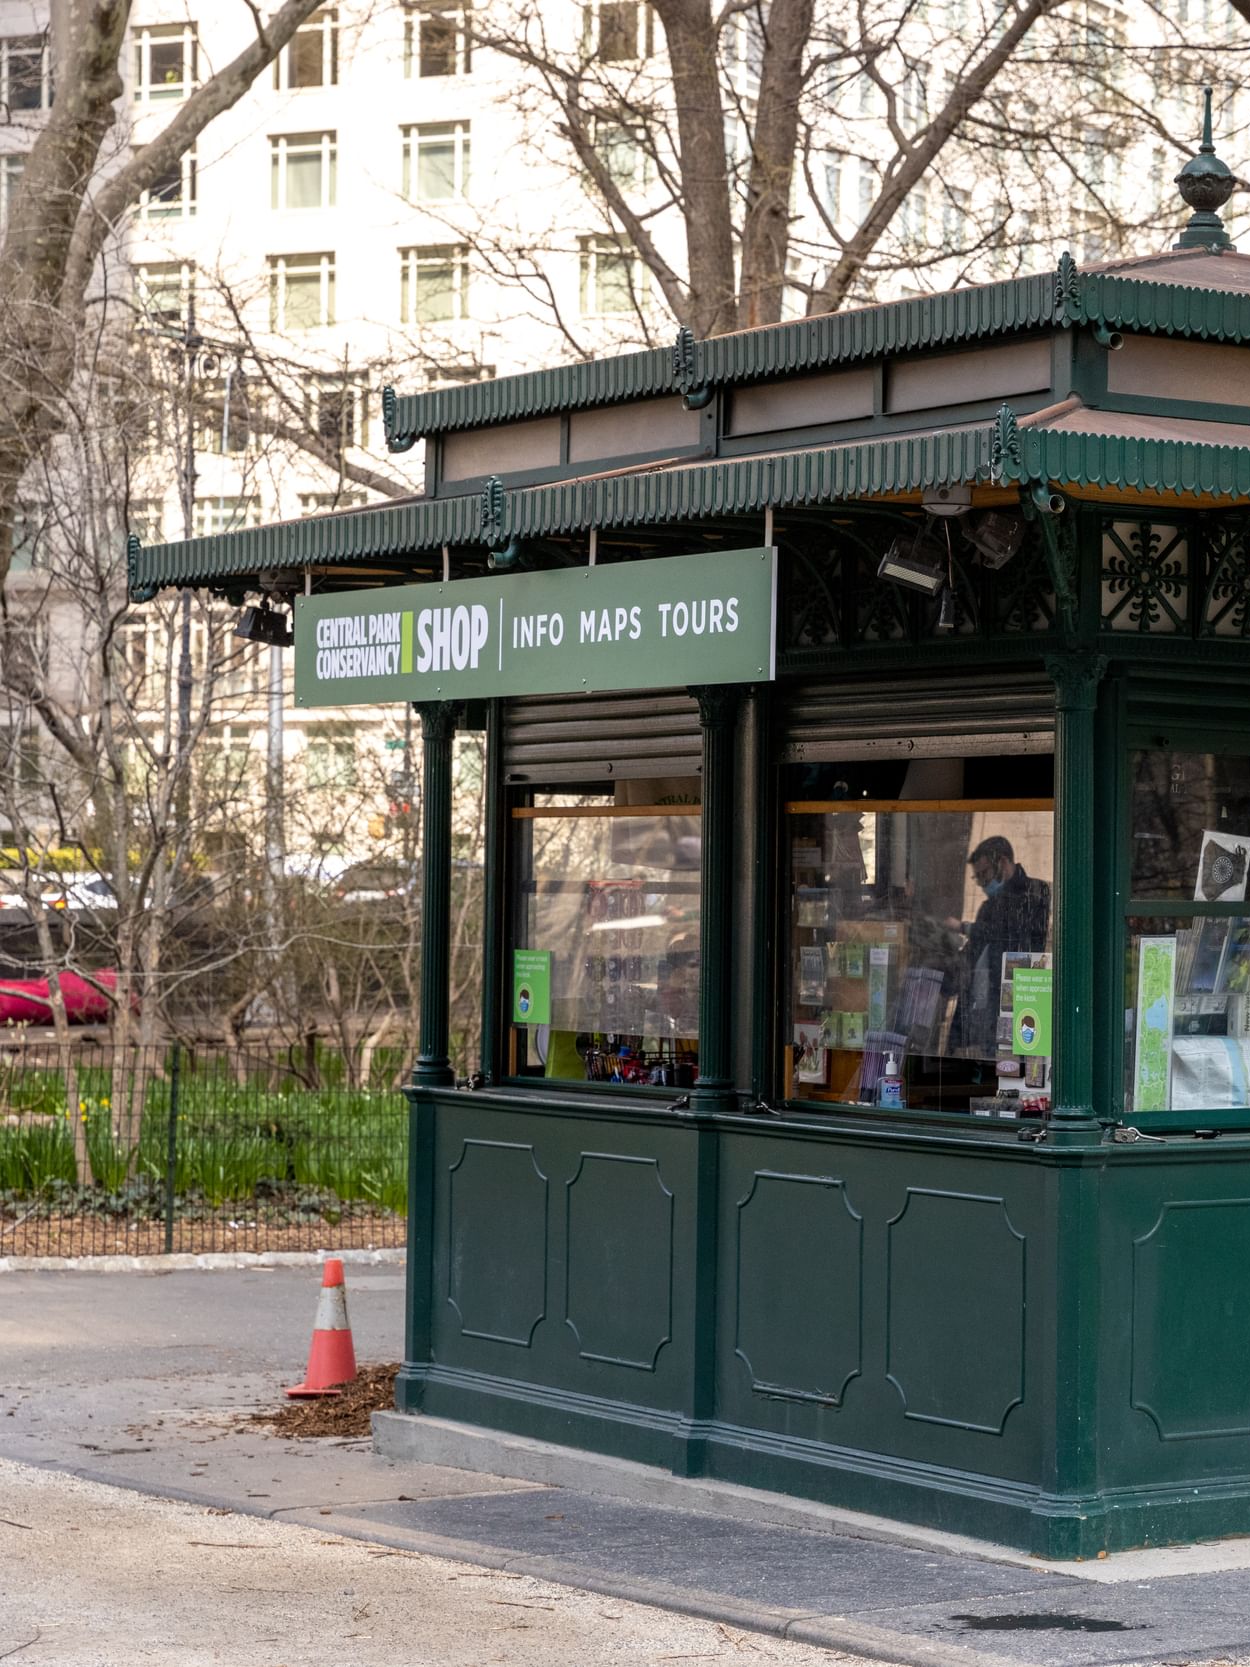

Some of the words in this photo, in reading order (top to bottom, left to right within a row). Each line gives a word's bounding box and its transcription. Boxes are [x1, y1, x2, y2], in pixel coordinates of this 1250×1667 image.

[316, 615, 368, 649] CENTRAL
[368, 612, 401, 644] PARK
[417, 604, 489, 673] SHOP
[513, 612, 564, 649] INFO
[579, 606, 642, 643] MAPS
[658, 597, 740, 637] TOURS
[316, 644, 401, 680] CONSERVANCY
